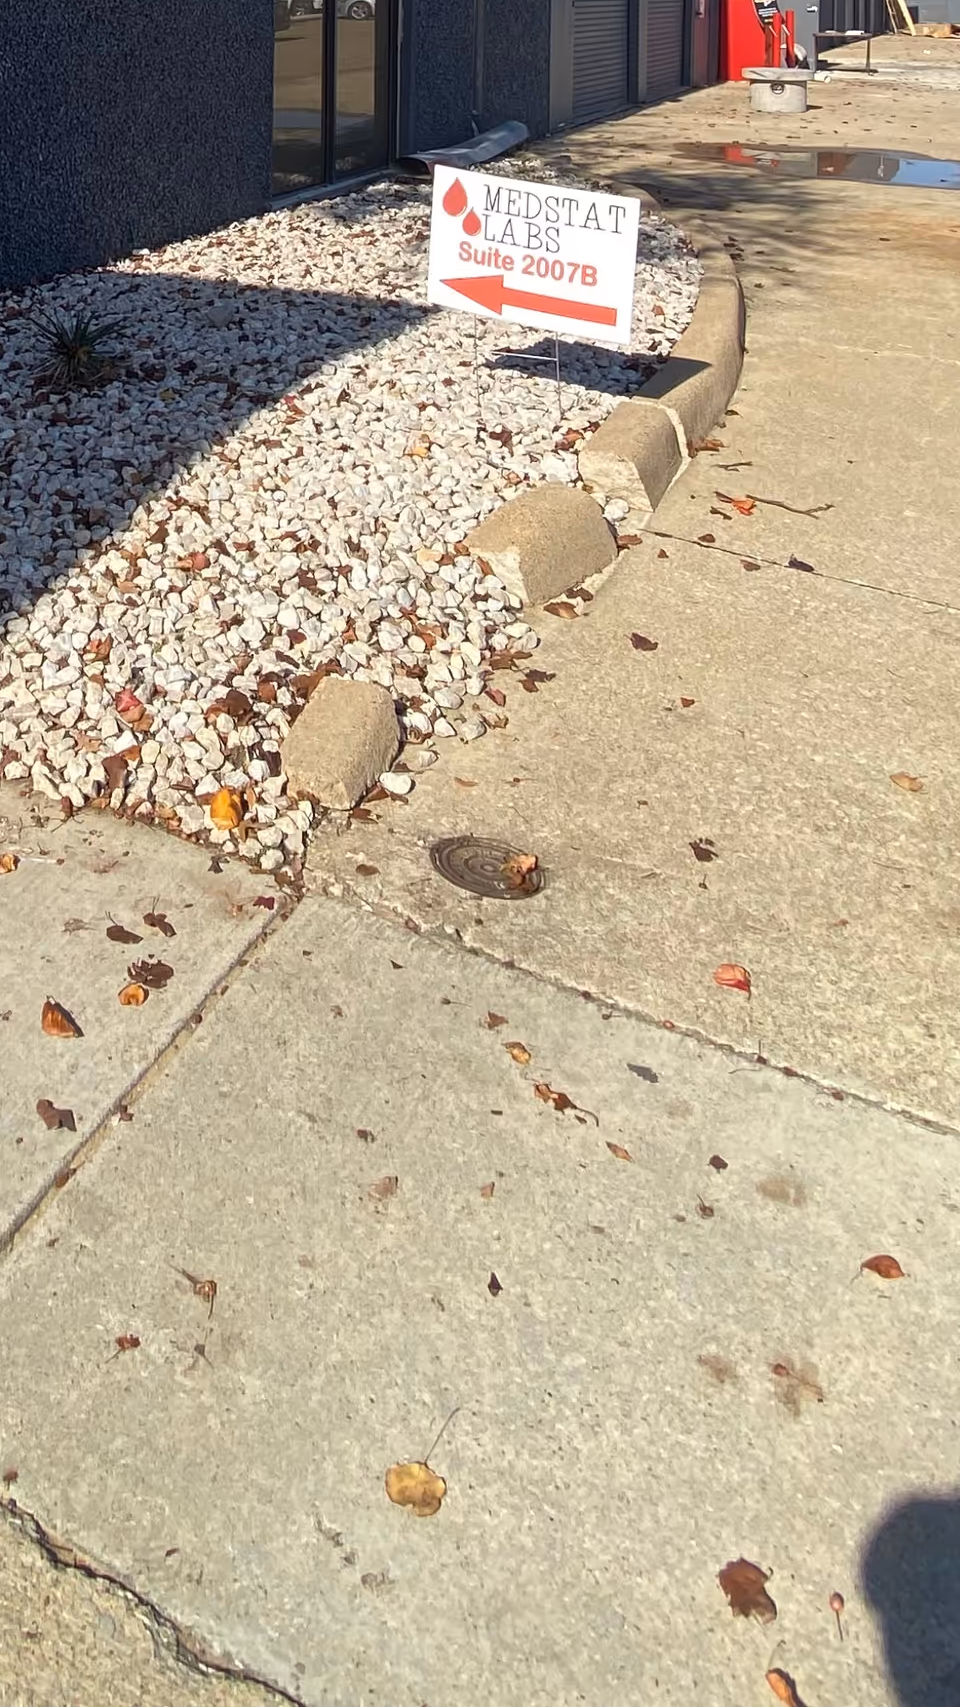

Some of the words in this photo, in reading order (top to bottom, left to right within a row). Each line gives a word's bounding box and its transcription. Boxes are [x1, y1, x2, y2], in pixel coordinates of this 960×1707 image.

[483, 184, 626, 234] MEDSTAT
[482, 213, 561, 253] LABS
[458, 240, 515, 271] Suite
[521, 254, 598, 287] 2007B
